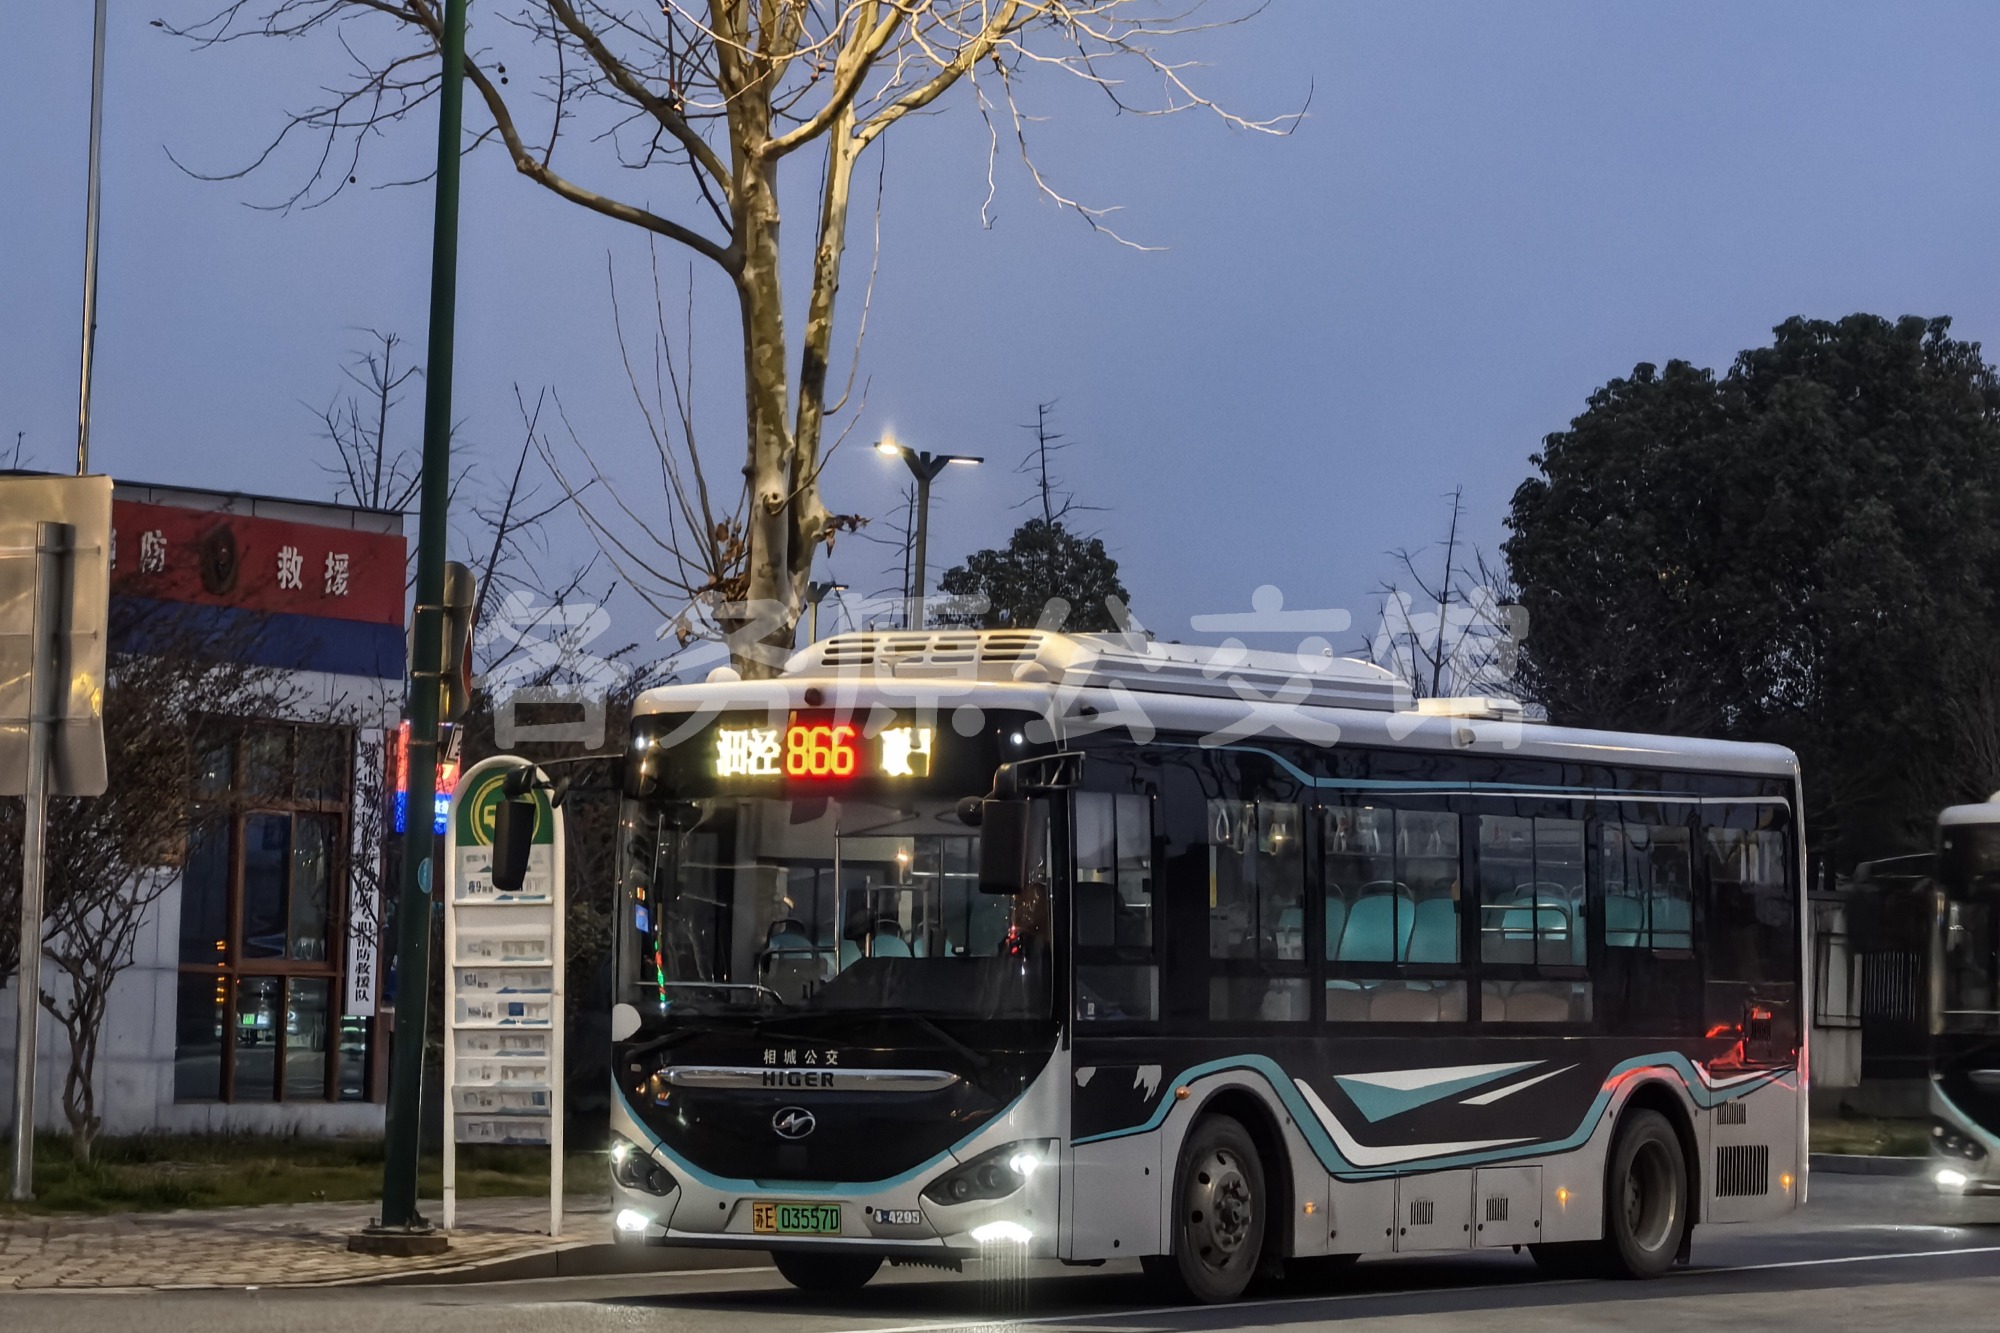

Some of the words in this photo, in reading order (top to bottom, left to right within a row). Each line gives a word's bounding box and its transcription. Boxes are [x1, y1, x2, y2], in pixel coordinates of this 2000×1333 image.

[277, 546, 349, 596] 救援
[787, 726, 855, 775] 866
[763, 1048, 839, 1066] 相城公交
[762, 1071, 834, 1088] HIGER
